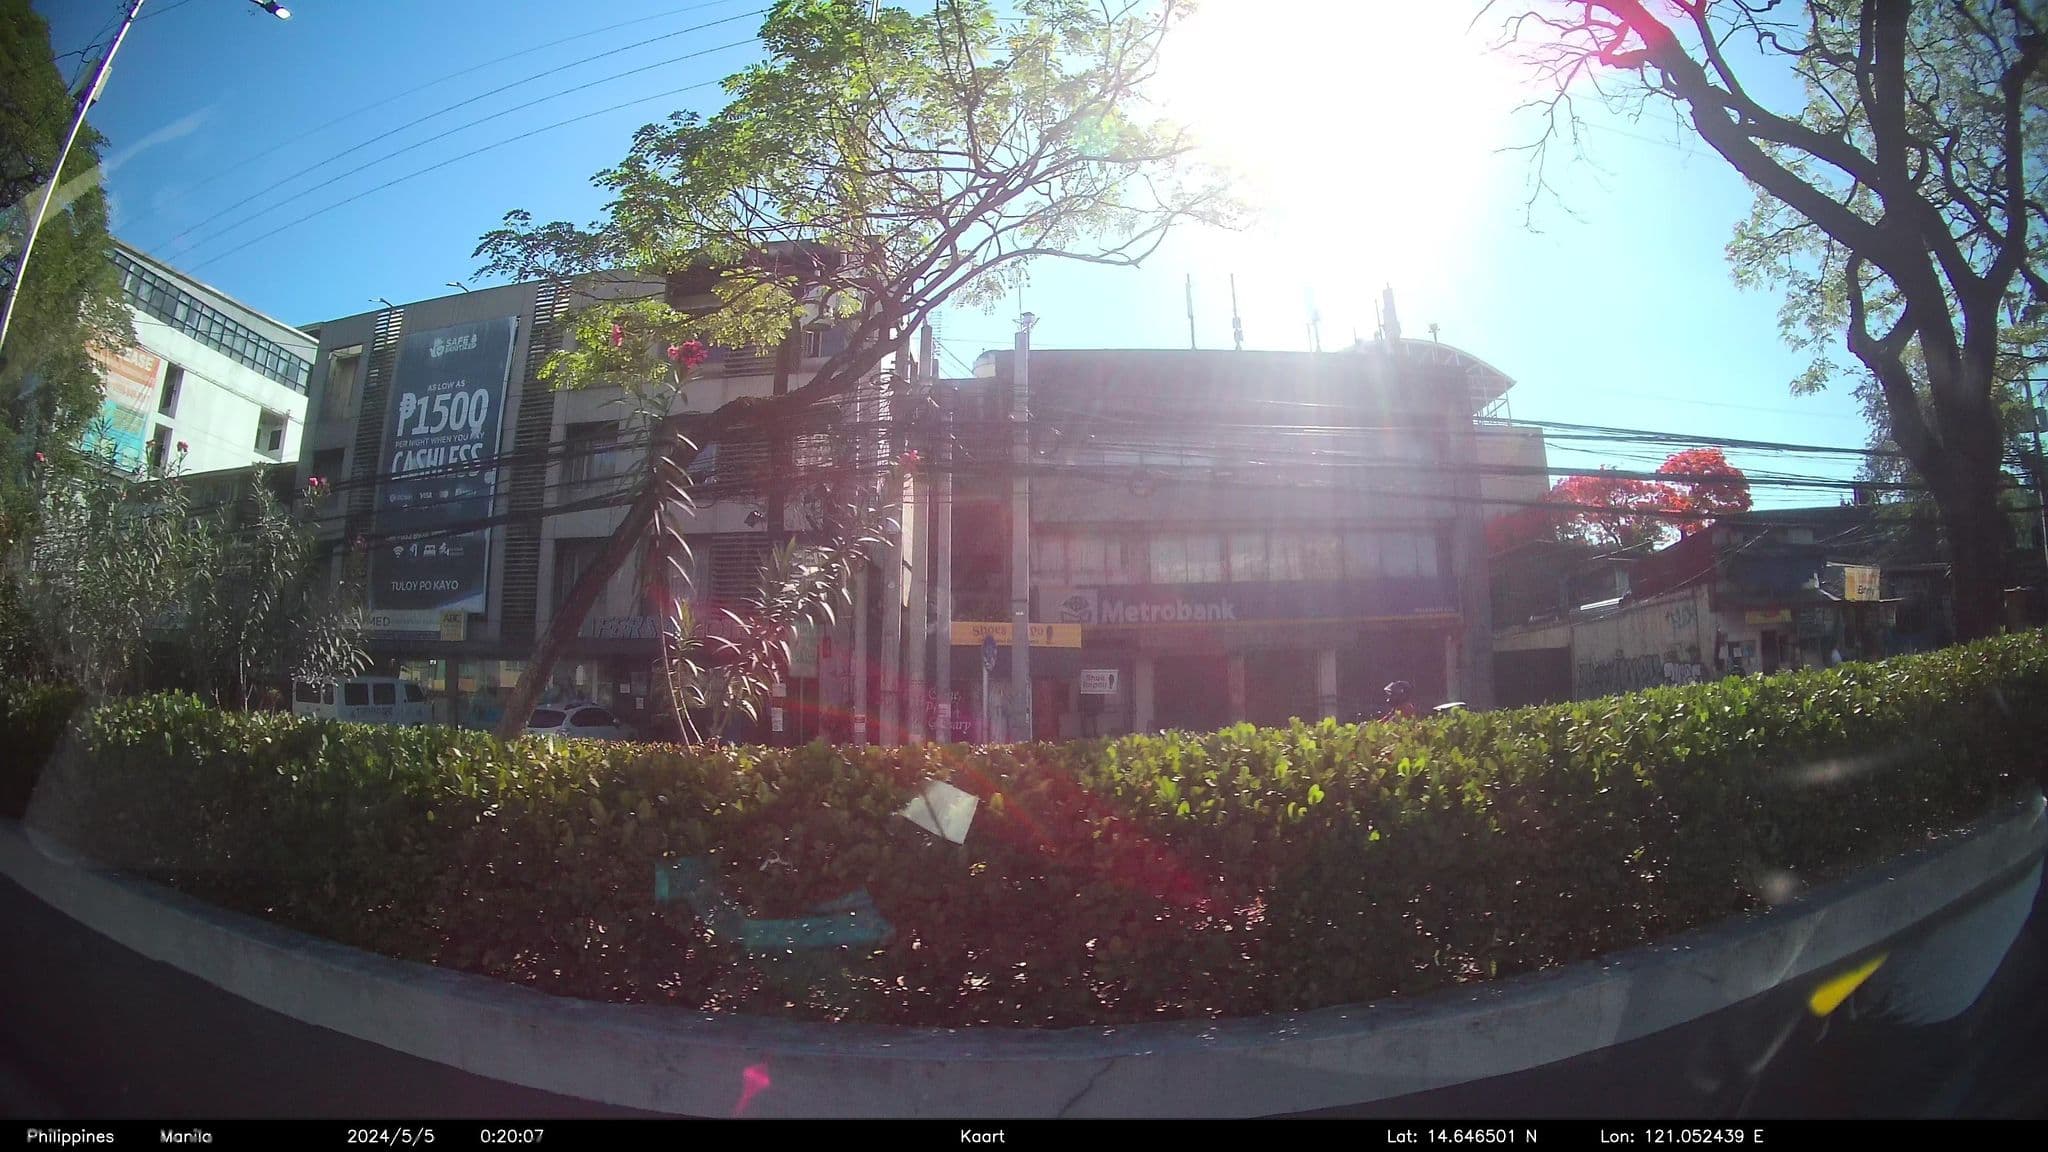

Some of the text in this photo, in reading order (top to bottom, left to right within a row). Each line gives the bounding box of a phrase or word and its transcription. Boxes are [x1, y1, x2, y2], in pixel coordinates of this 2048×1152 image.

[455, 379, 466, 388] AS
[430, 436, 452, 445] WHEN
[452, 433, 468, 442] YOU
[392, 581, 418, 591] TULOY
[433, 580, 459, 591] KAYO
[1101, 597, 1237, 623] Metrobank
